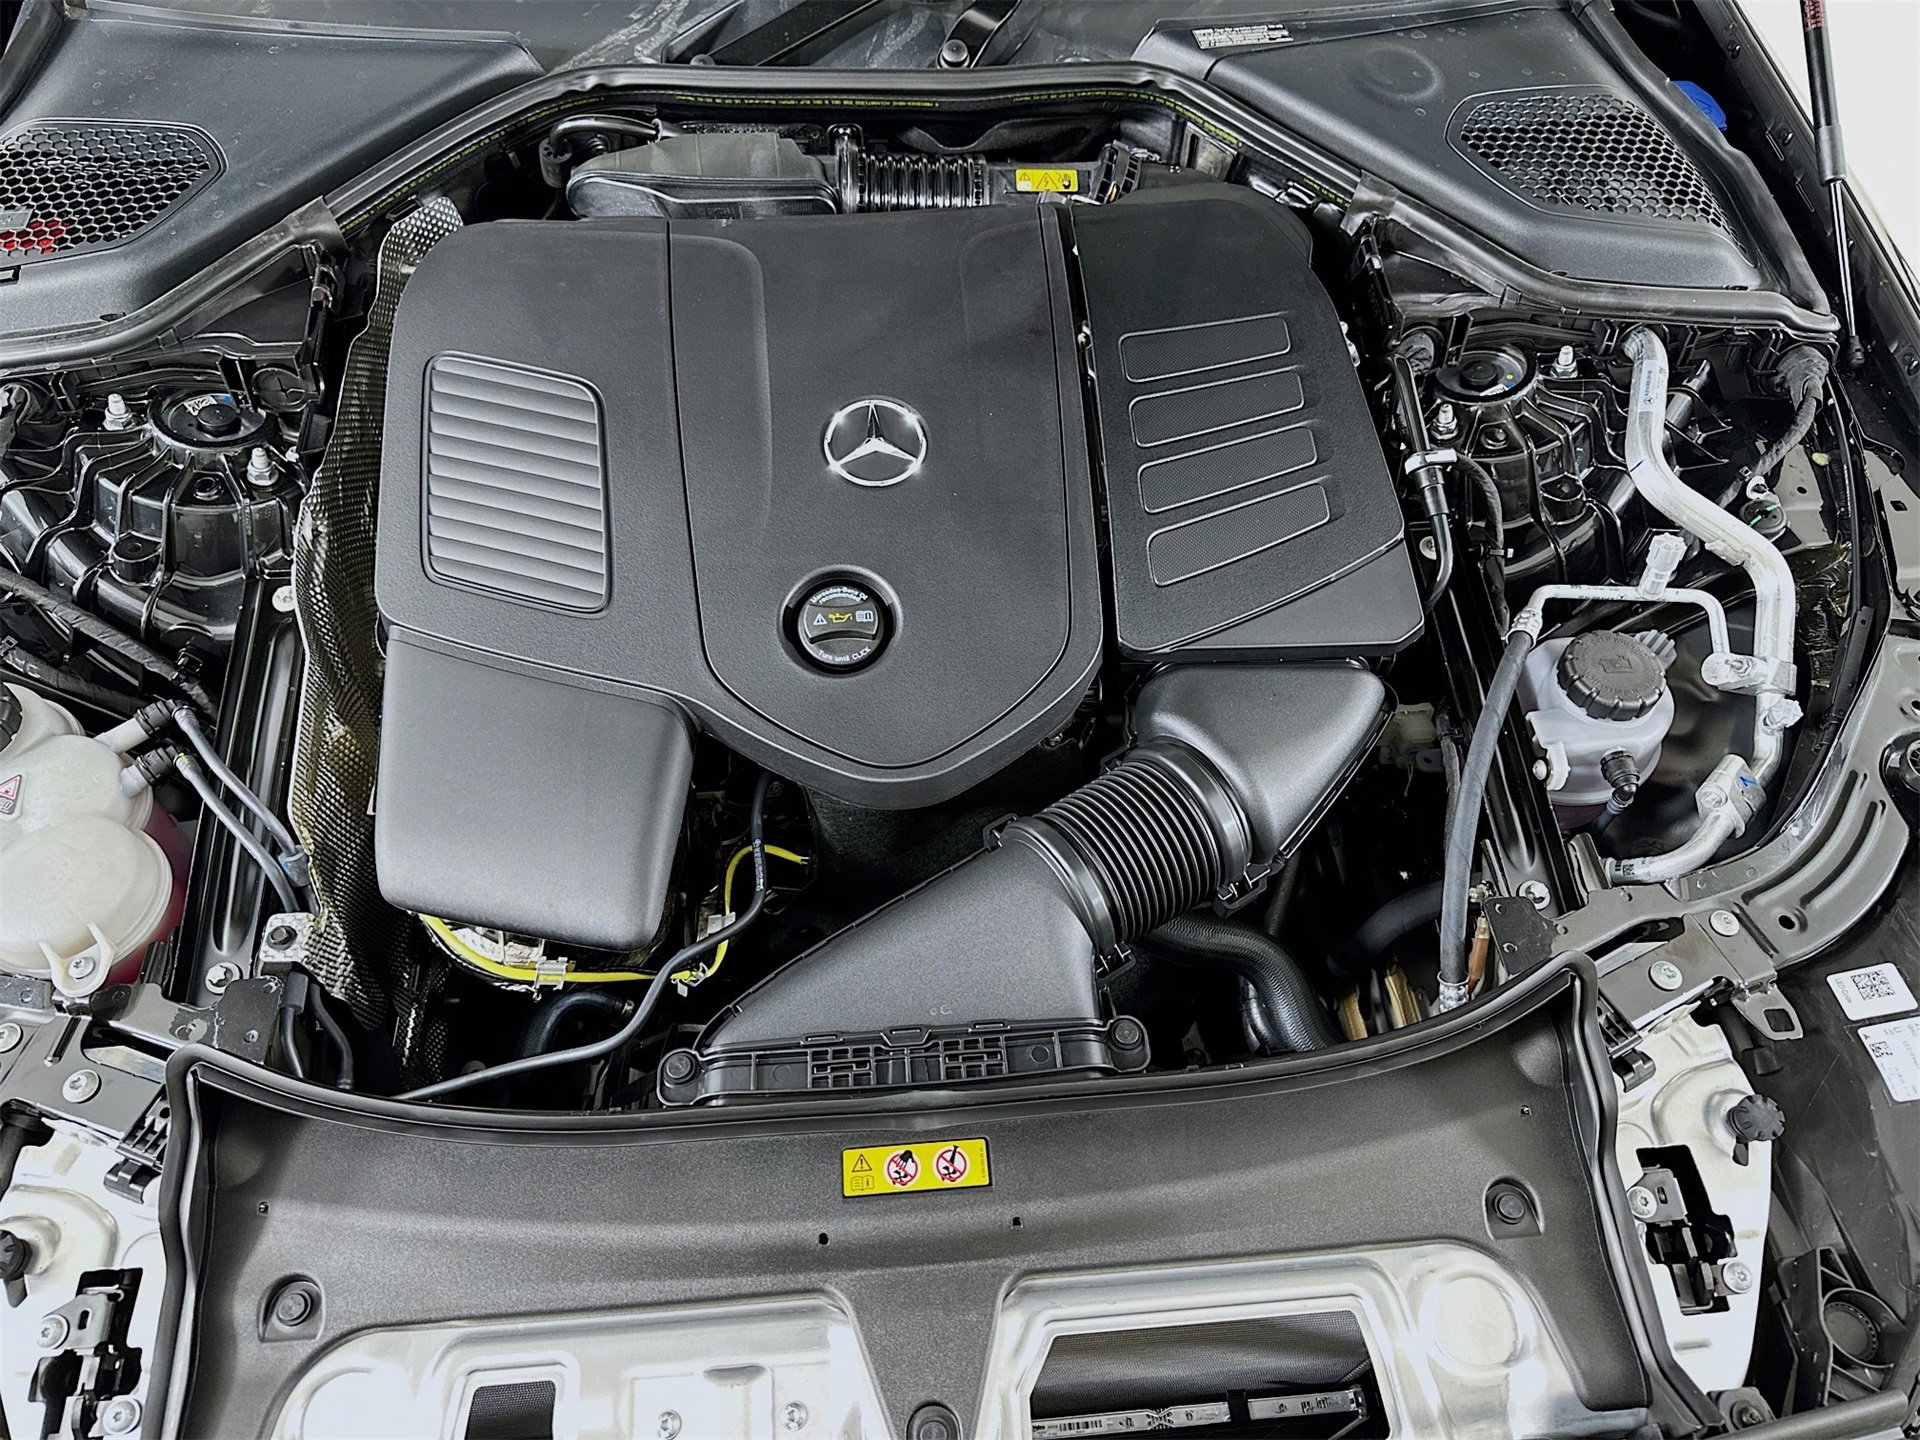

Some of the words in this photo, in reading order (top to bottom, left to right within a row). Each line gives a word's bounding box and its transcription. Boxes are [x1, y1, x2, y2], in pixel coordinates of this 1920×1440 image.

[810, 587, 859, 604] Mercedes-Benz
[818, 649, 833, 660] Turn
[851, 646, 871, 660] CLICK
